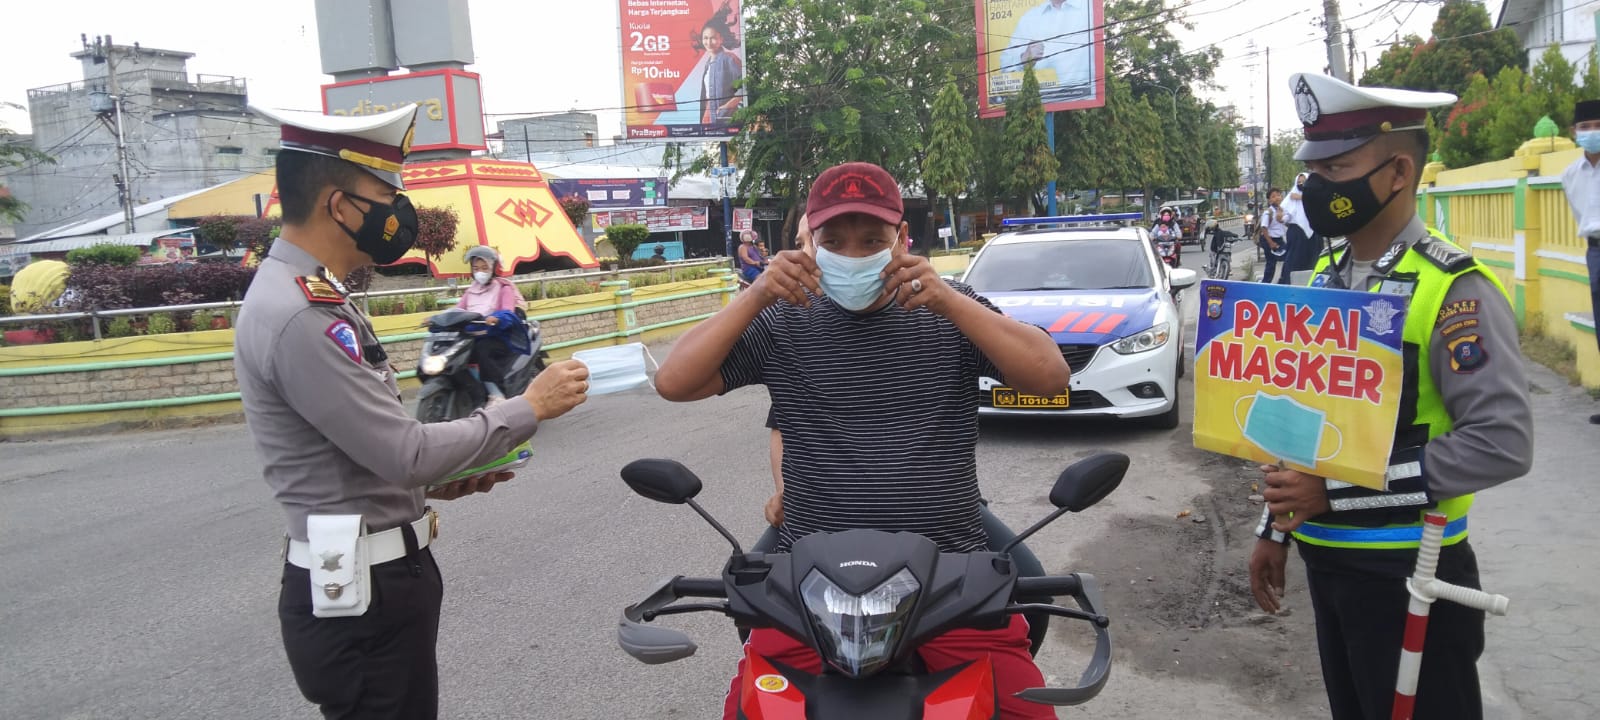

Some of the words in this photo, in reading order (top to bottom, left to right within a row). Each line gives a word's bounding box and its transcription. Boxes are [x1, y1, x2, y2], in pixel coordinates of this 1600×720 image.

[990, 10, 1012, 20] 2024
[630, 31, 670, 52] 2GB
[988, 294, 1126, 308] OLISI
[1234, 300, 1361, 351] PAKAI
[1209, 340, 1385, 405] MASKER
[1021, 397, 1066, 405] 1010-48
